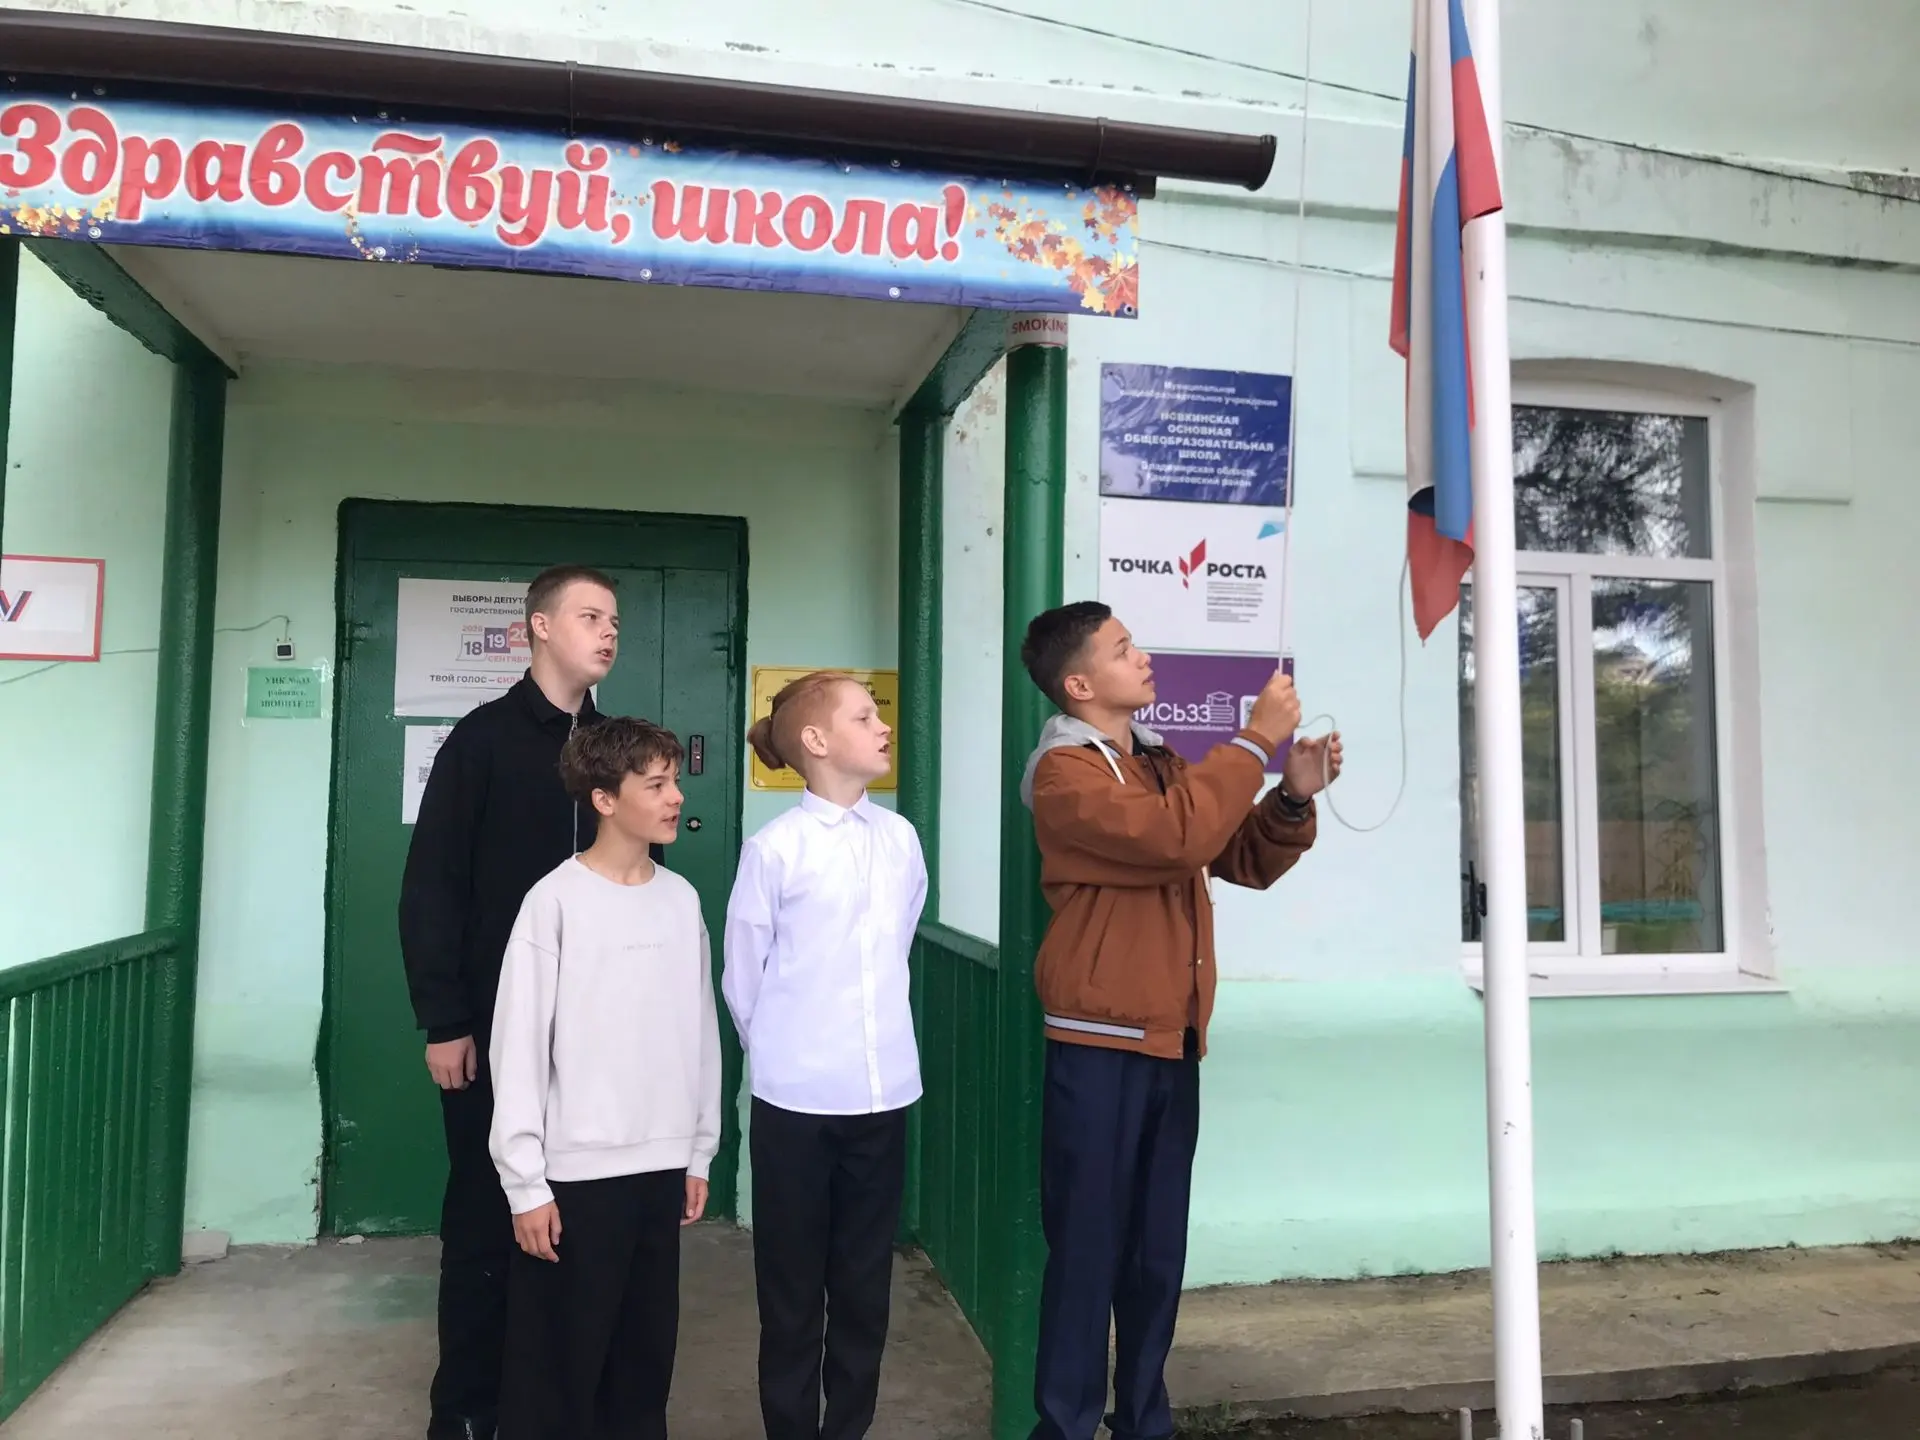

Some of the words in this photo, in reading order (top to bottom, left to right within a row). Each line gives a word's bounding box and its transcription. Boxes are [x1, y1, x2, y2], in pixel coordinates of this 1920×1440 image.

[0, 103, 632, 248] Здравствуй,
[650, 185, 967, 262] школа!
[1167, 424, 1233, 437] ОСНОВНАЯ
[1123, 434, 1275, 451] ОБЩЕОБРАЗОВАТЕЛЬНАЯ
[1178, 450, 1221, 461] ШКОЛА
[1108, 558, 1174, 575] ТОЧКА
[1206, 563, 1267, 579] РОСТА
[452, 594, 492, 603] ВЫБОРЫ
[450, 606, 524, 616] ГОСУДАРСТВЕННОЙ
[464, 641, 483, 656] 18
[486, 633, 506, 649] 19
[429, 674, 455, 683] ТВОЙ
[456, 676, 487, 684] ГОЛОС
